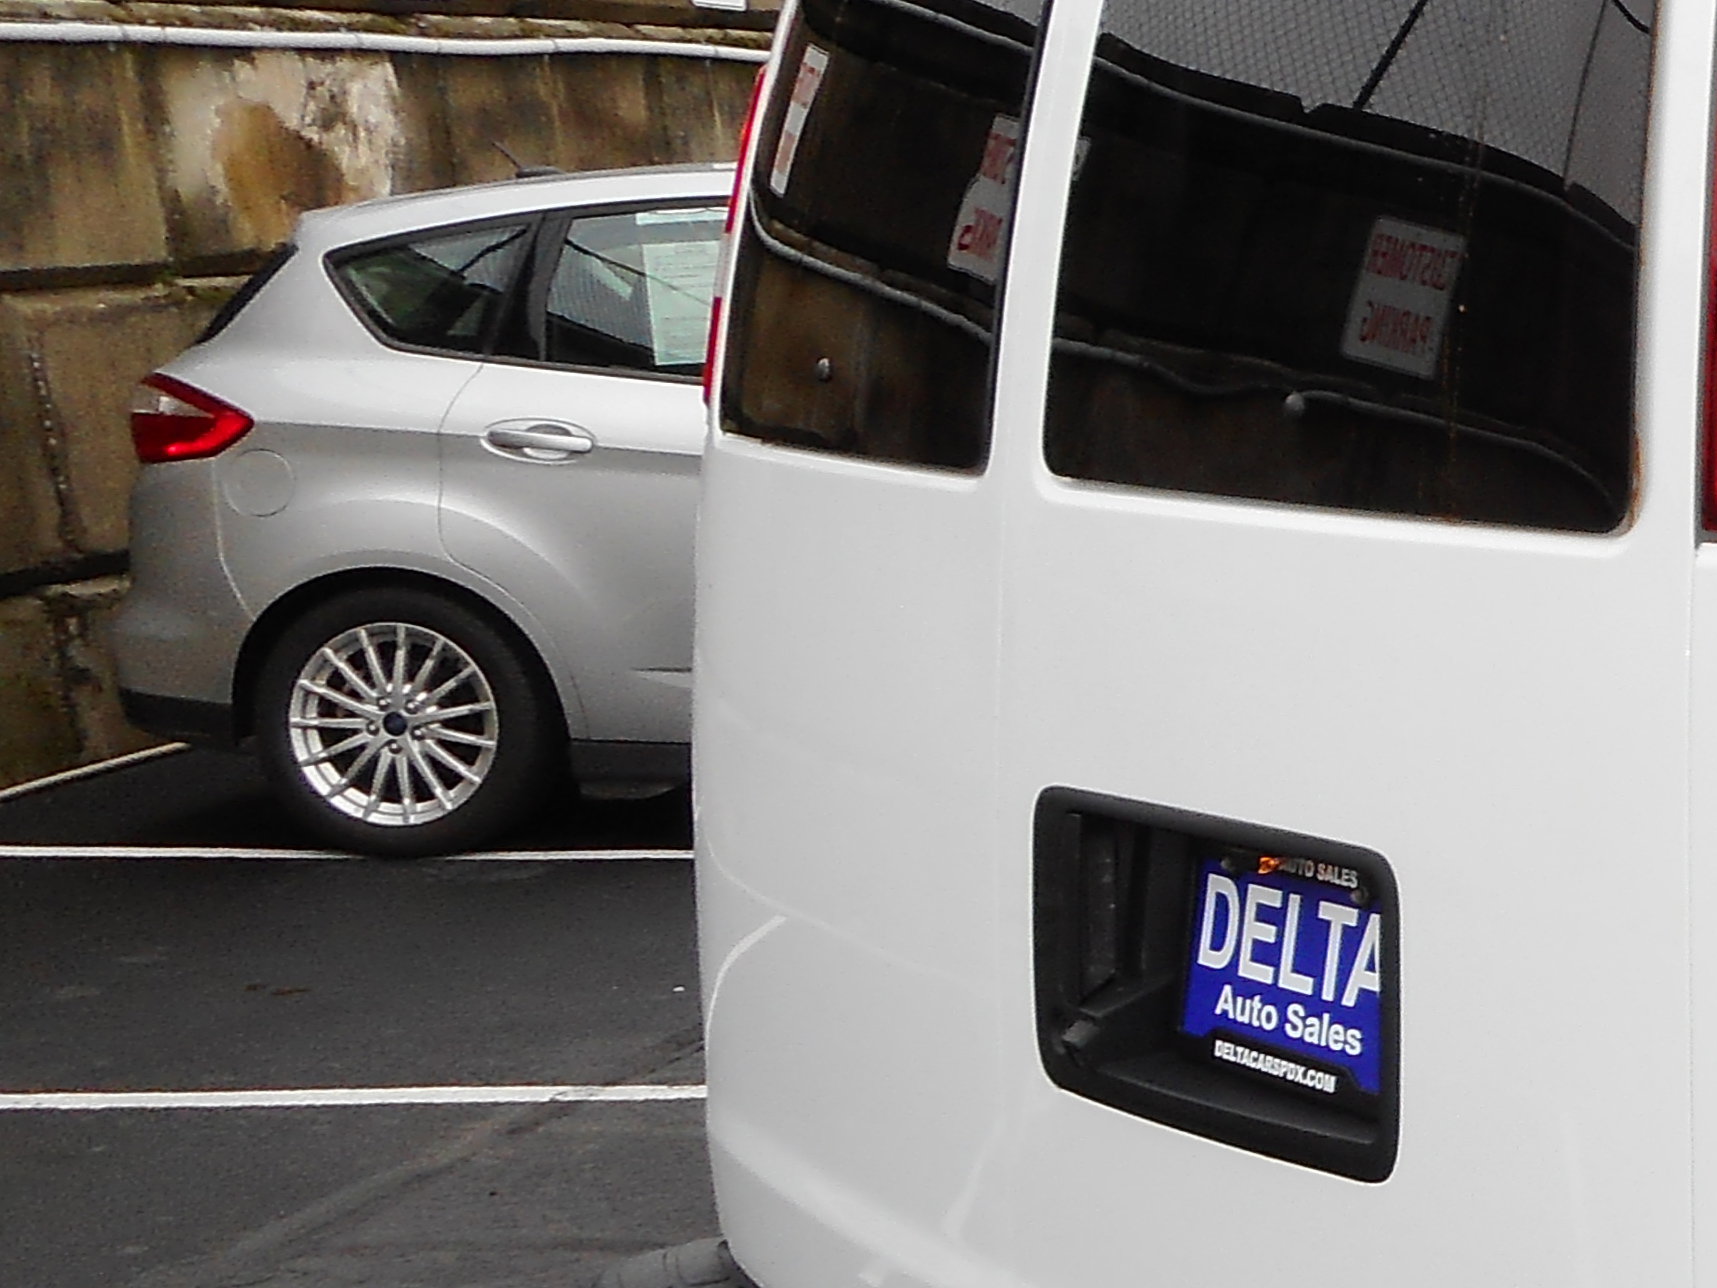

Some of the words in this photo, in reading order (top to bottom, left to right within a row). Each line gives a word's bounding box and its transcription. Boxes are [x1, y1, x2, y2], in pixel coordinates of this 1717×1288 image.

[1316, 864, 1359, 889] SALES
[1197, 872, 1382, 1008] DELTA
[1214, 984, 1279, 1031] Auto
[1284, 1003, 1363, 1056] Sales
[1213, 1040, 1338, 1094] DELTACARSPDX.COM
